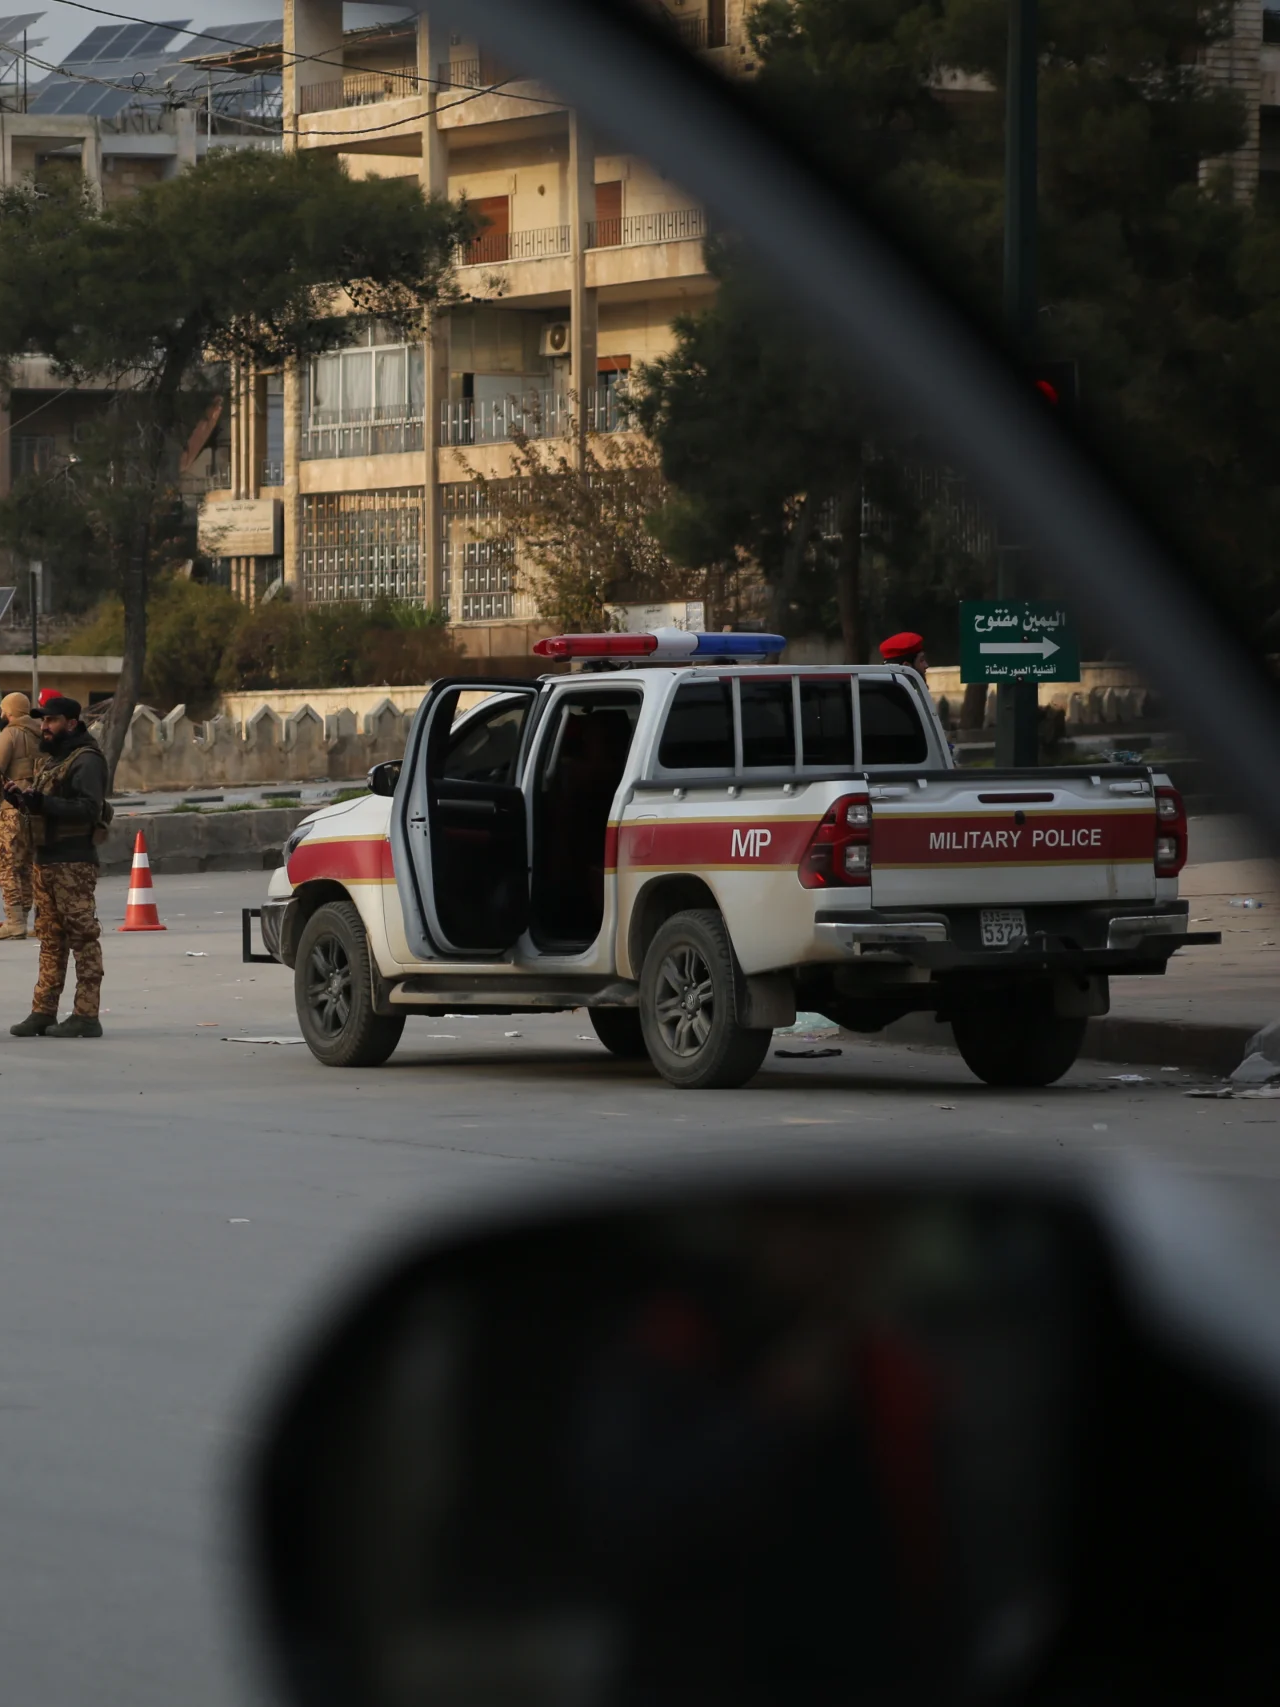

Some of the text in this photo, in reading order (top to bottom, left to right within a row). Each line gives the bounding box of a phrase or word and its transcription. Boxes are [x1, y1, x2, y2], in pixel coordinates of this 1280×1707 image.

[974, 608, 1066, 632] اليمين مفتوح
[985, 663, 1057, 677] أفضلية العبور للمشاة
[731, 828, 772, 858] MP
[929, 828, 1102, 850] MILITARY POLICE
